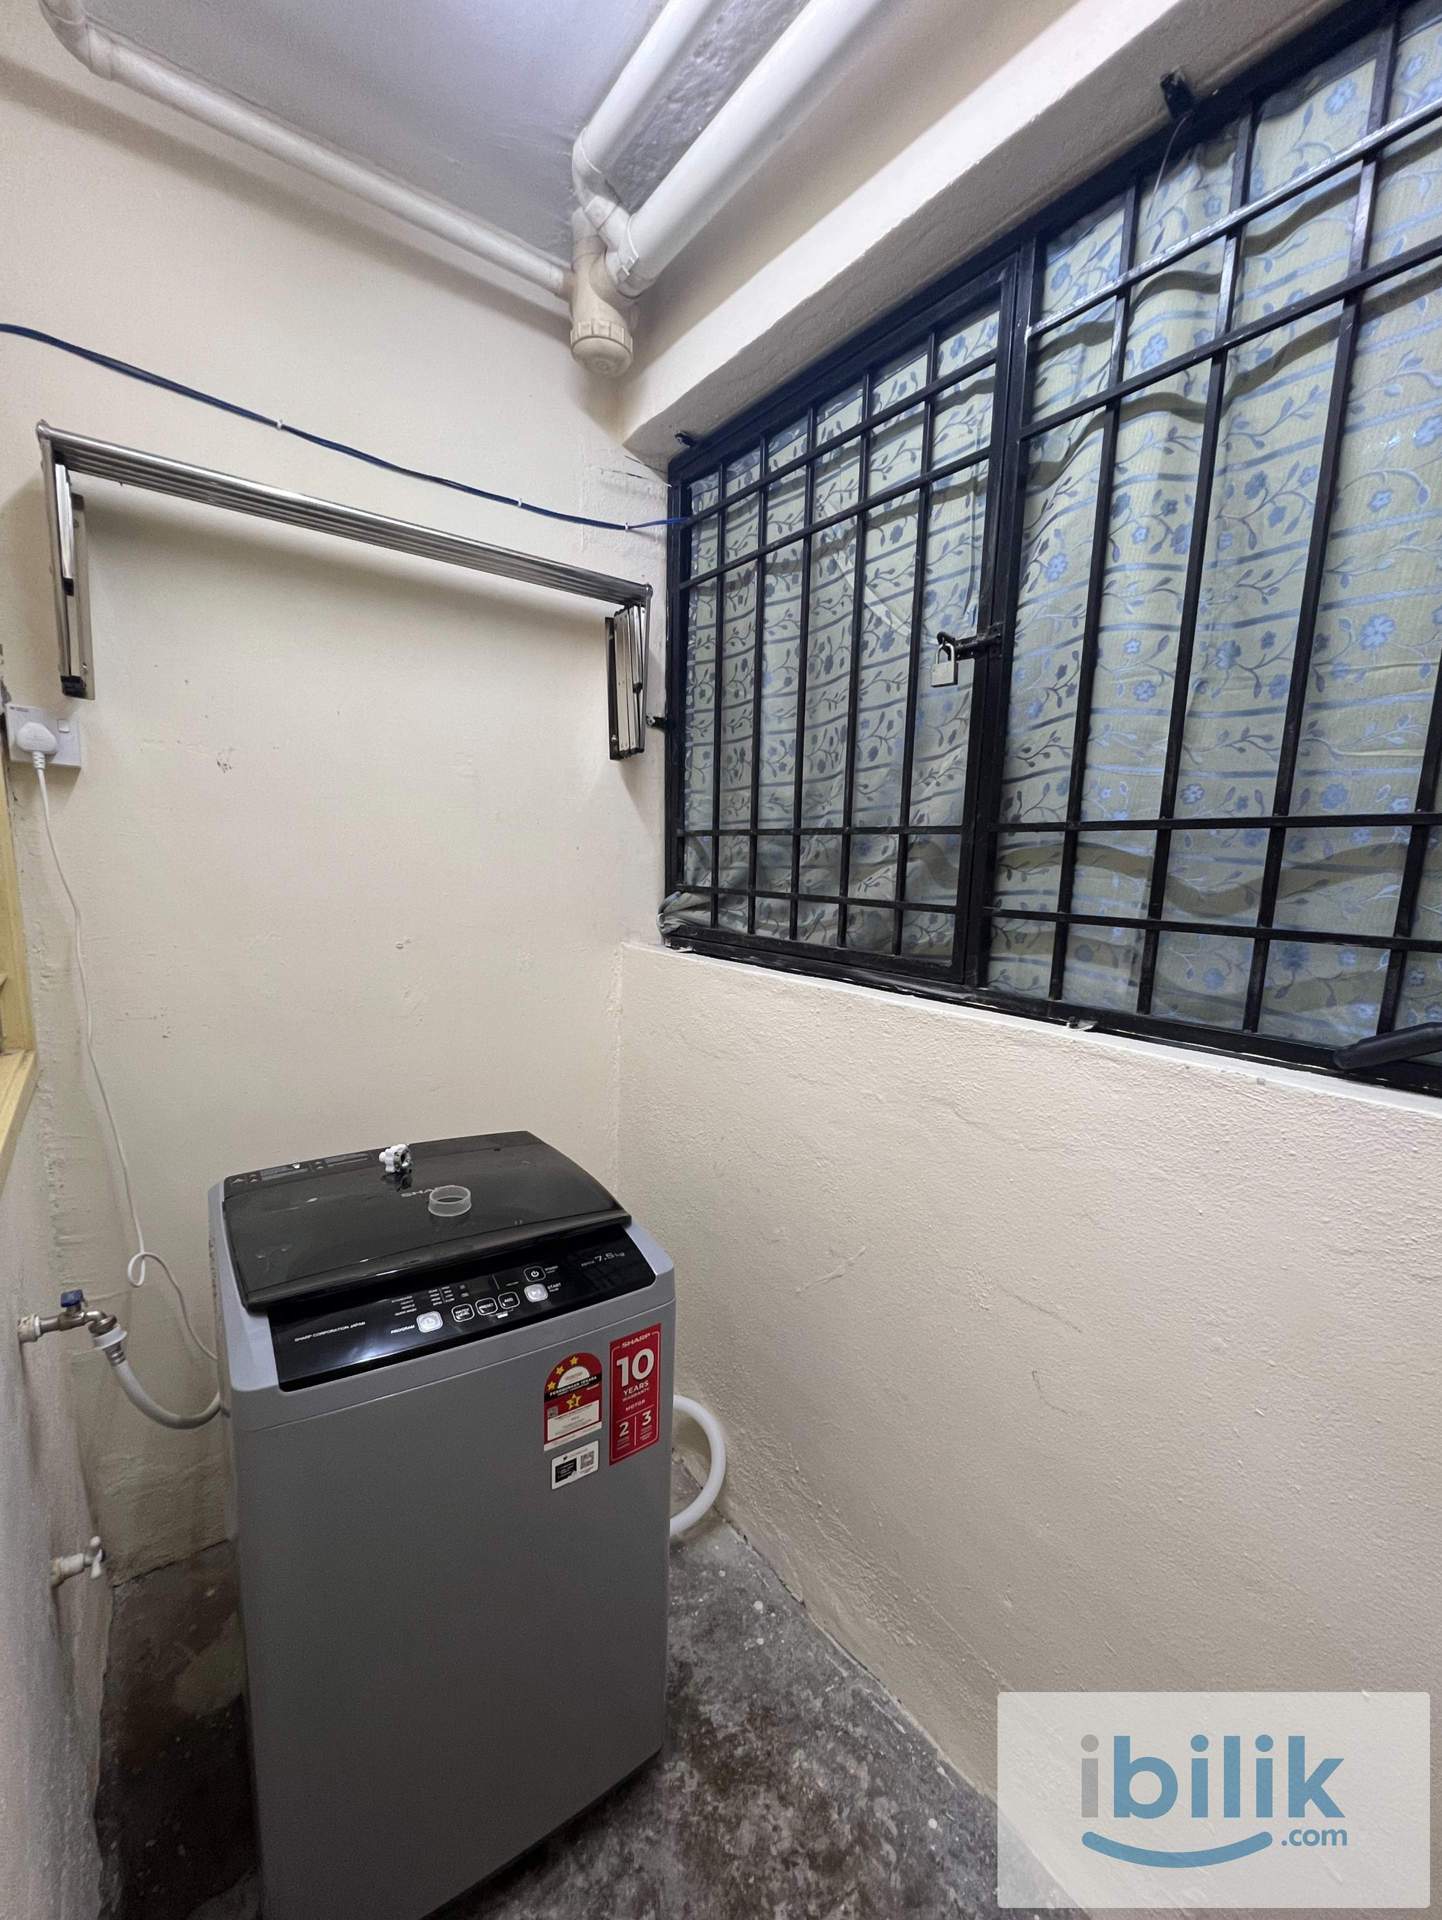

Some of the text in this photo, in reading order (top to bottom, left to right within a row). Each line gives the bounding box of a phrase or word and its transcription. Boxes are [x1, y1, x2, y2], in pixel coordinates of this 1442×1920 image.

[622, 1332, 651, 1348] SHARP
[616, 1348, 655, 1387] 10
[623, 1380, 649, 1397] YEARS
[642, 1410, 652, 1426] 3
[619, 1421, 630, 1437] 2
